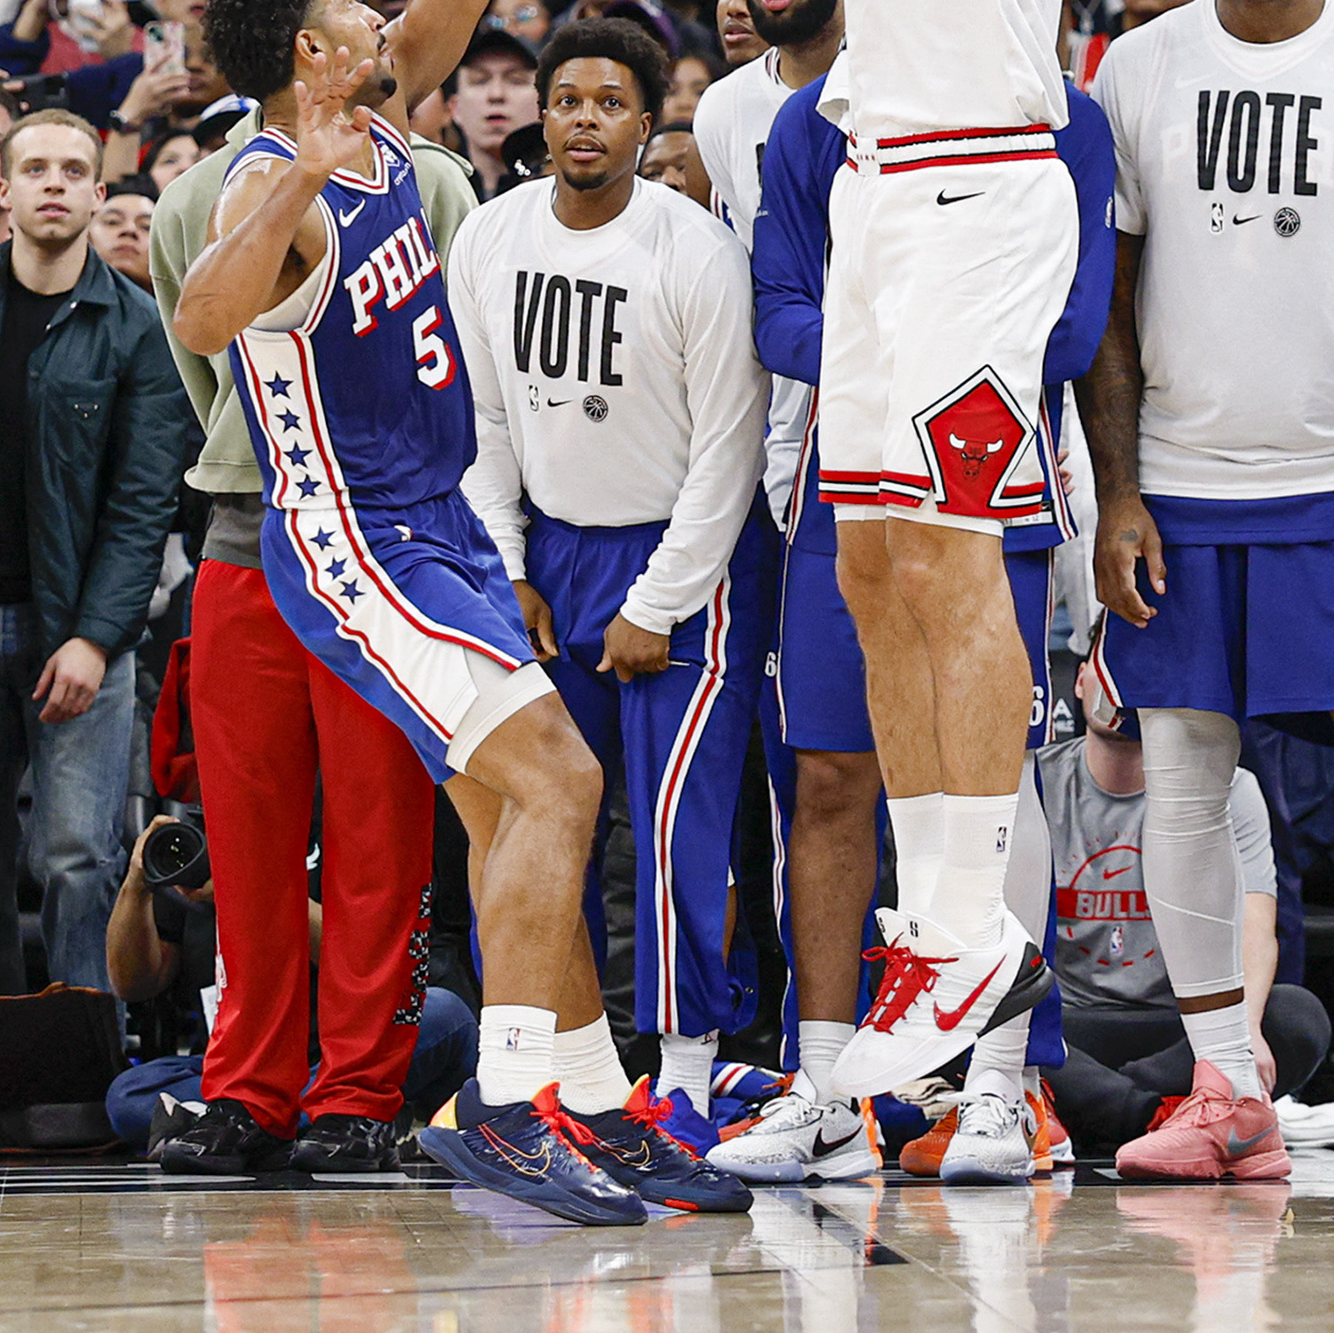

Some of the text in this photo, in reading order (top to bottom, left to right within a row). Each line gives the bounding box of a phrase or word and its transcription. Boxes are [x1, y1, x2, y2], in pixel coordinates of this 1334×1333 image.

[1196, 89, 1323, 197] VOTE
[412, 305, 457, 391] 5
[514, 271, 628, 387] VOTE
[1075, 892, 1151, 920] BULL
